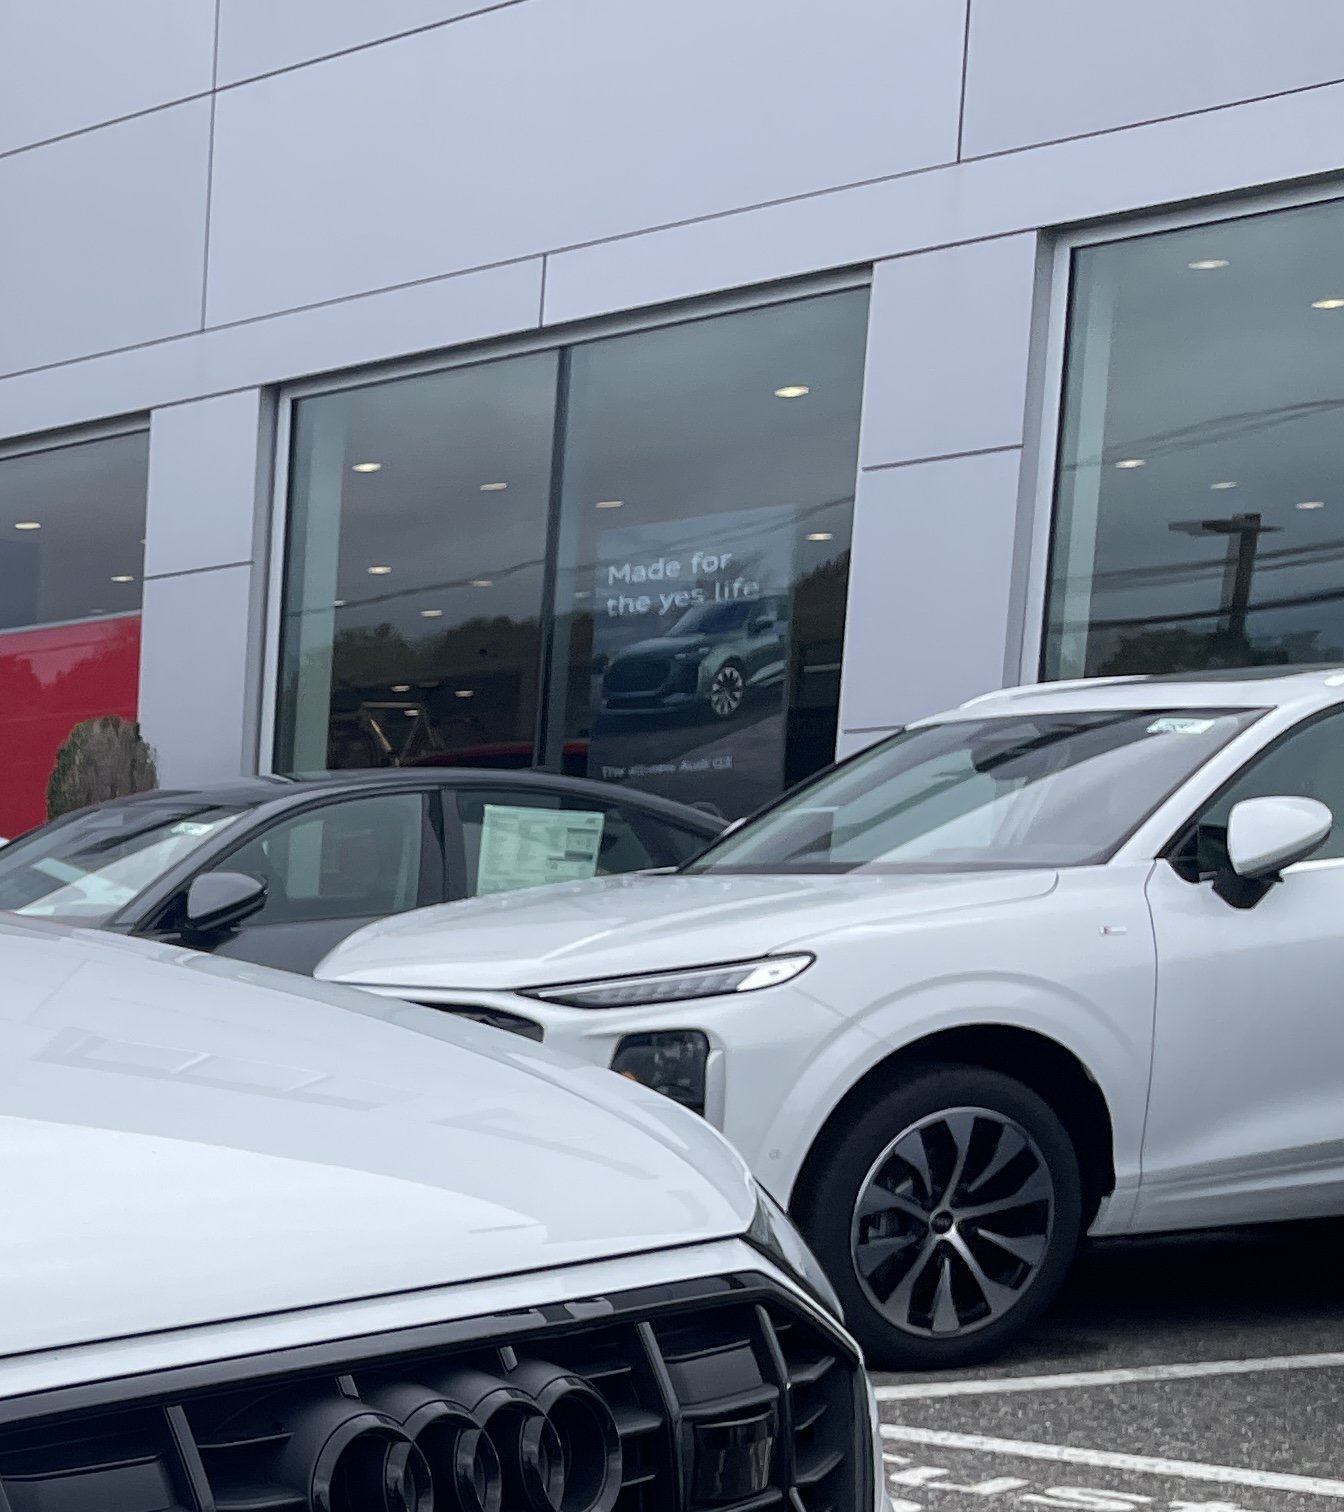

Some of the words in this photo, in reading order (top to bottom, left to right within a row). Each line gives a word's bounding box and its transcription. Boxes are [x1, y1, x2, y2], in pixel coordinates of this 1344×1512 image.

[608, 558, 681, 586] Made
[692, 551, 732, 574] for
[607, 594, 651, 617] the
[659, 588, 706, 616] yes
